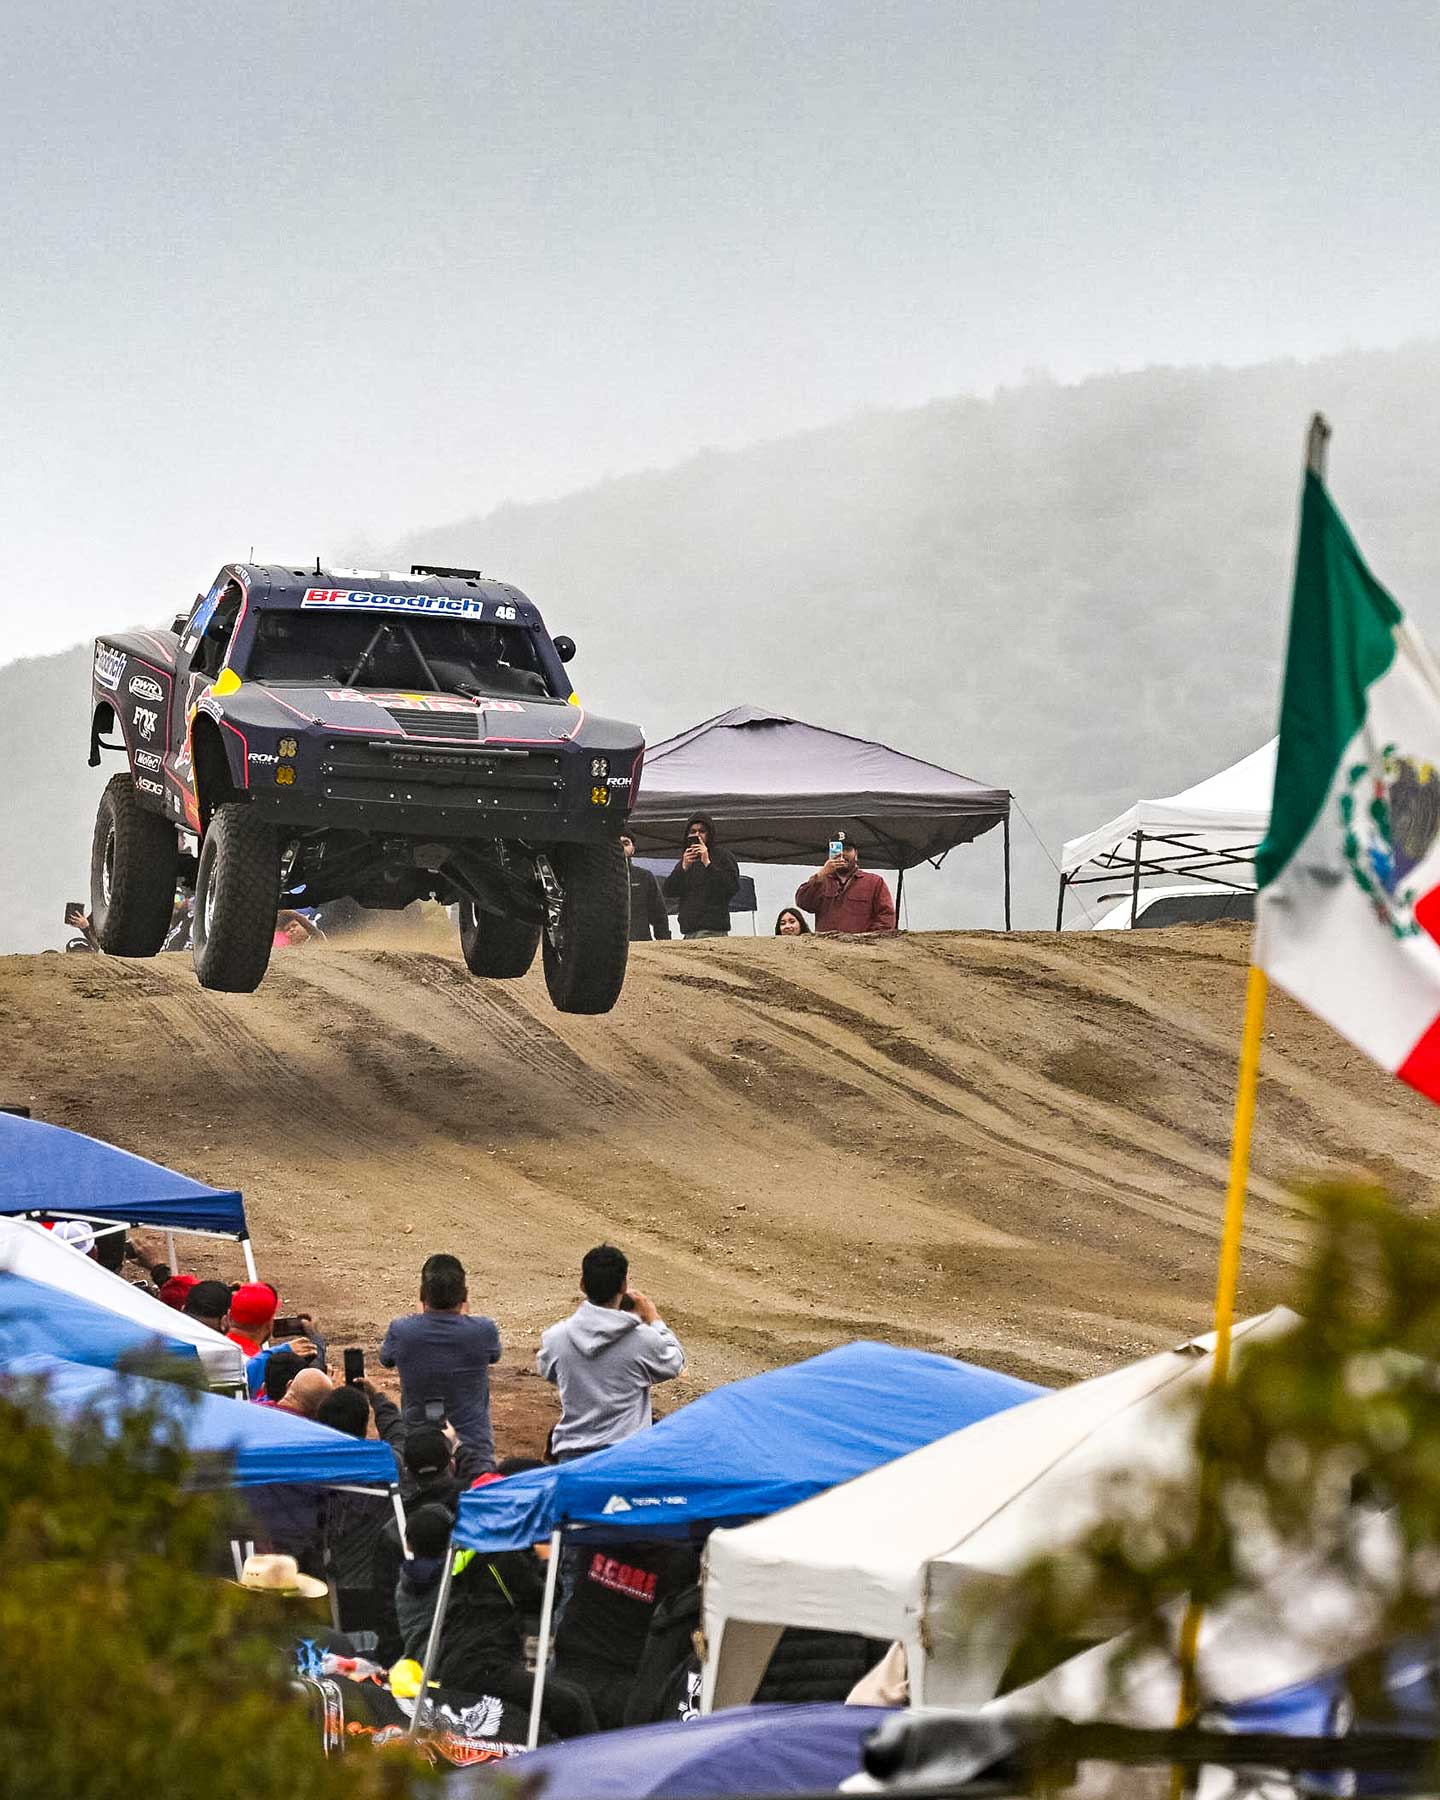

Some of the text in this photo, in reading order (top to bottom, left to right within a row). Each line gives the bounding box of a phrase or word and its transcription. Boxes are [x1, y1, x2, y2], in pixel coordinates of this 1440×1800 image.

[307, 590, 479, 612] BFGoodrich
[495, 606, 516, 620] 46
[131, 678, 158, 694] PWR
[133, 706, 158, 732] FOX
[248, 753, 279, 763] ROH
[606, 777, 632, 786] ROH
